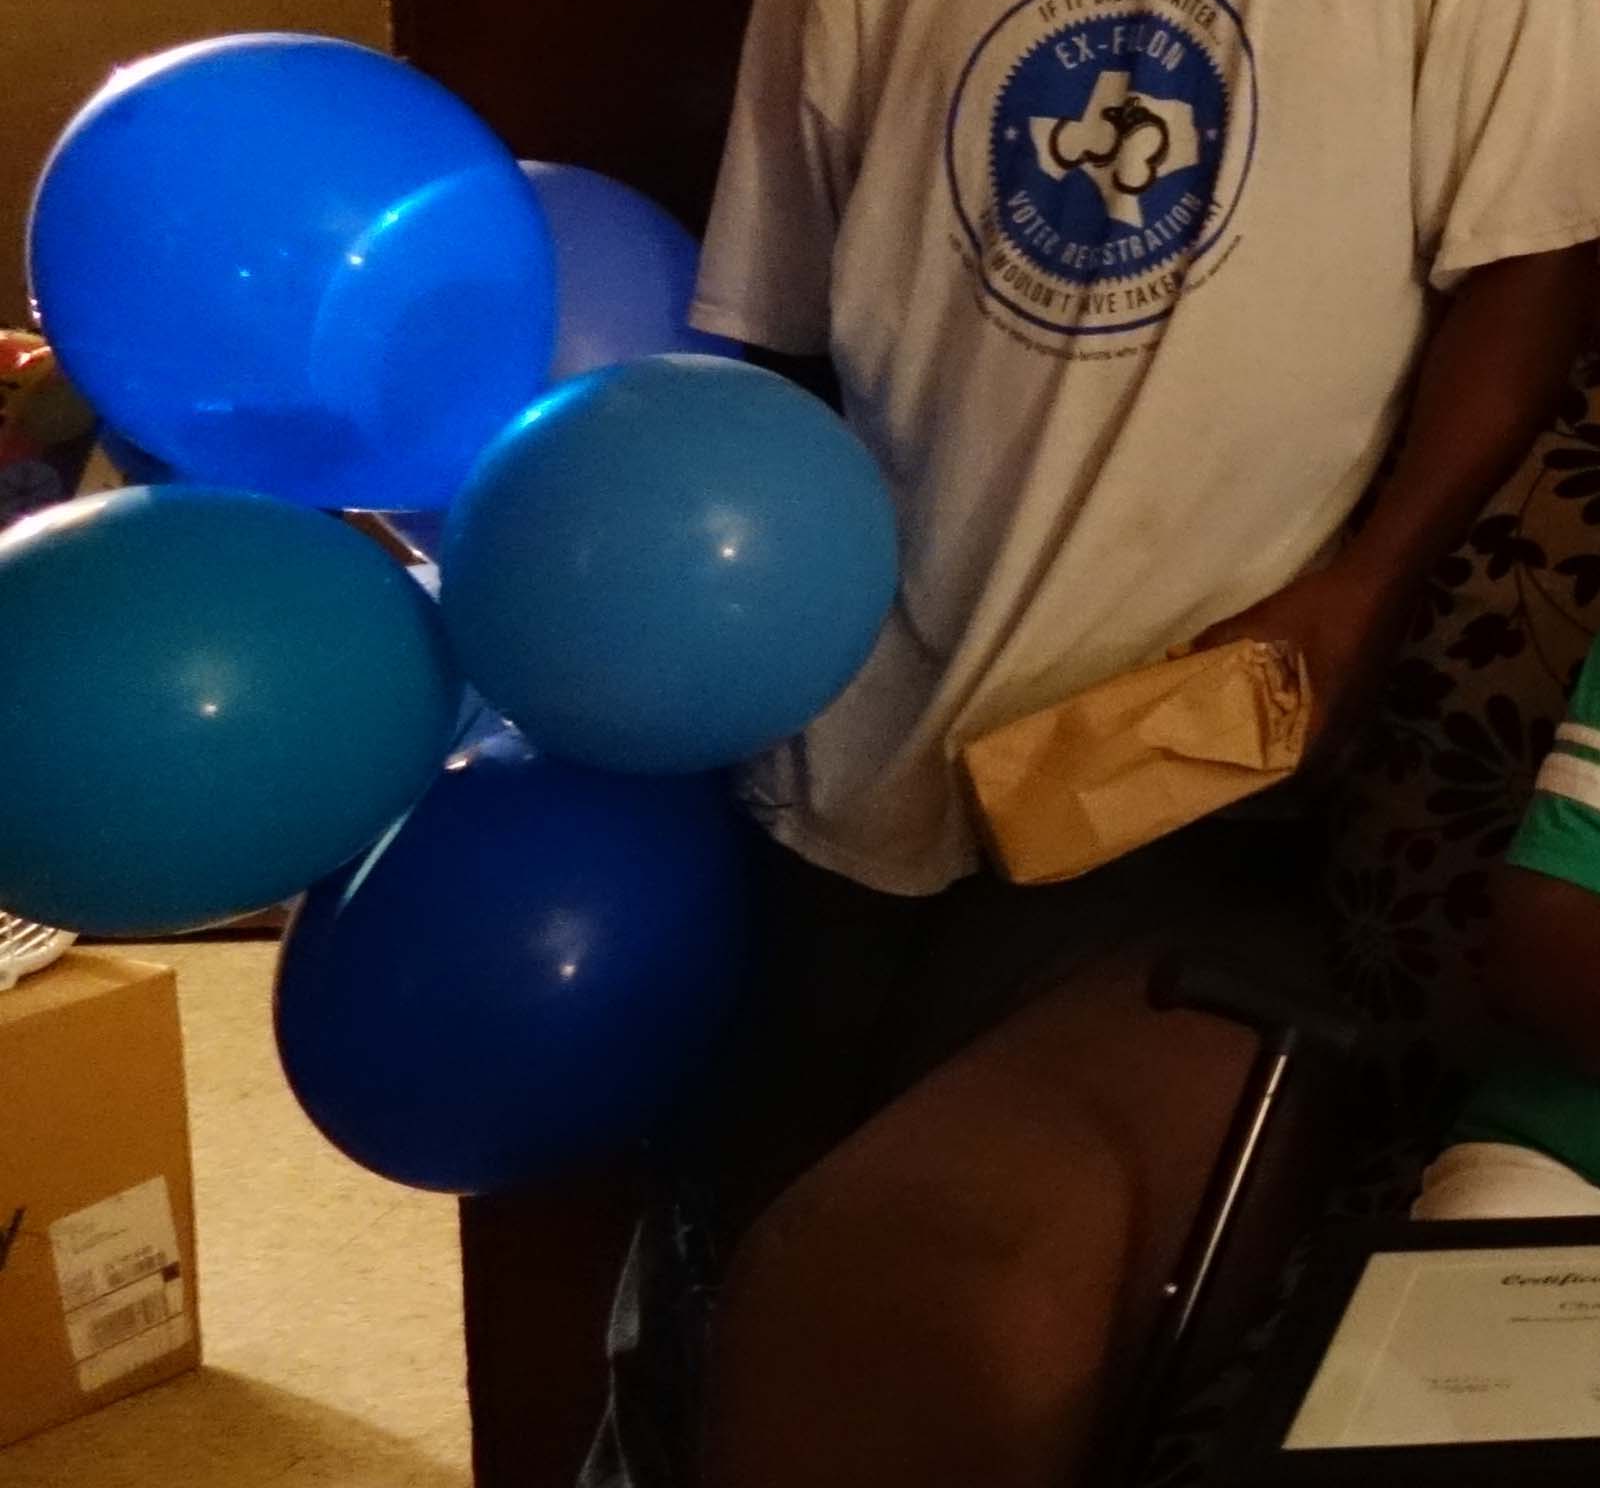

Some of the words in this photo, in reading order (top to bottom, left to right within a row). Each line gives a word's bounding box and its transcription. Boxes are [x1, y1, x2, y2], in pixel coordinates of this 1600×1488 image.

[1037, 0, 1058, 23] IF
[1054, 24, 1187, 72] EX-FLON
[1060, 191, 1202, 269] RESTRATION
[1125, 271, 1182, 311] TAKE
